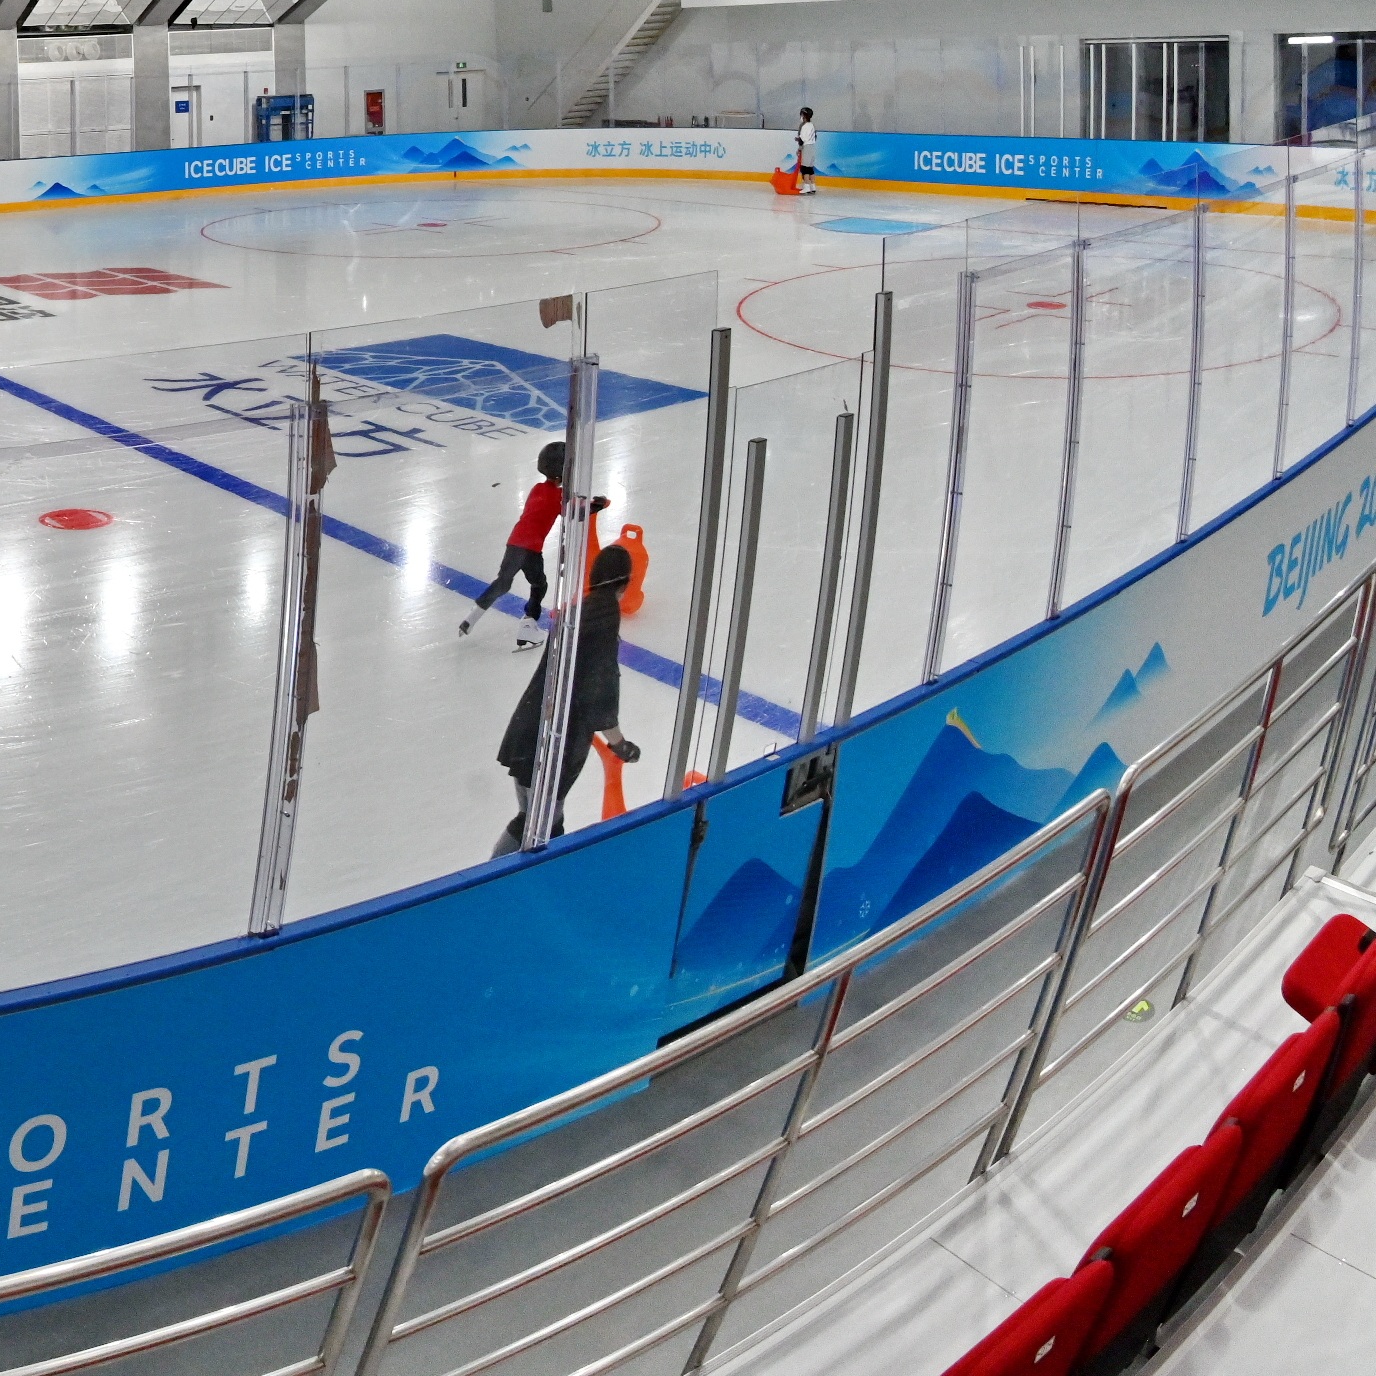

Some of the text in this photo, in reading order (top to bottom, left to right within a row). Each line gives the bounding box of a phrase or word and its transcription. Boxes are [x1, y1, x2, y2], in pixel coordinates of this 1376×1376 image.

[586, 140, 727, 159] 冰立方 冰上运动中心
[265, 154, 292, 172] ICE
[296, 150, 355, 162] SPORTS
[305, 158, 366, 170] CENTER
[995, 154, 1025, 175] ICE
[1028, 154, 1092, 168] SPORTS
[1039, 166, 1103, 179] CENTER
[395, 402, 528, 440] CUBE
[1262, 491, 1352, 618] BEIJING
